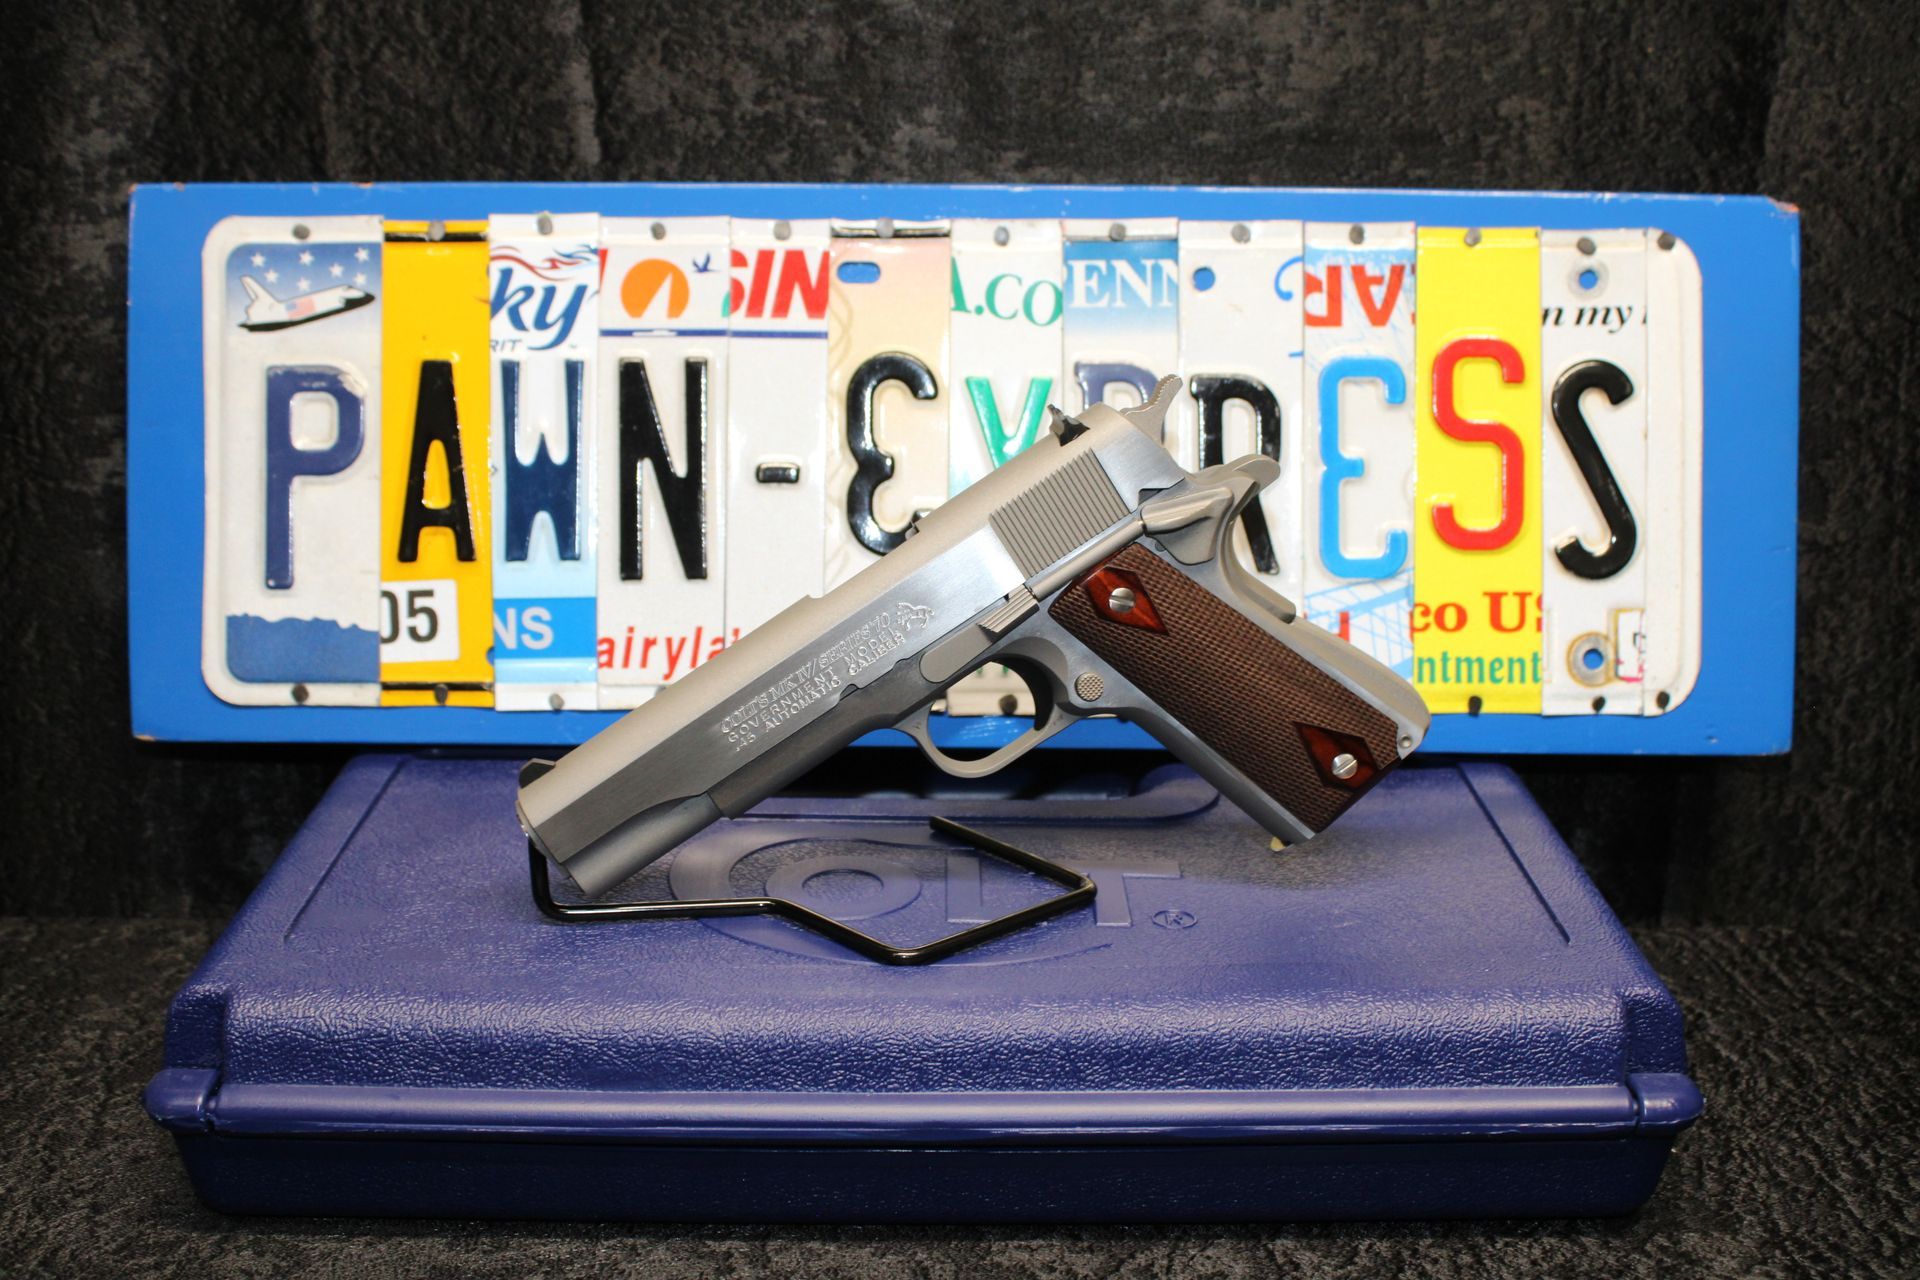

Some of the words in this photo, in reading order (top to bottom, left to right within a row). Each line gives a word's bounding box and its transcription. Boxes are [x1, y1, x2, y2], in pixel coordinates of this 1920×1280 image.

[1574, 305, 1633, 334] my
[381, 589, 439, 645] 05
[494, 607, 555, 650] NS
[1483, 590, 1543, 634] U
[728, 665, 834, 743] GOVERNMENT
[844, 627, 896, 667] MODEL
[764, 674, 841, 733] AUTOMATIC
[847, 630, 906, 676] CALIBER
[1417, 650, 1541, 684] ntment
